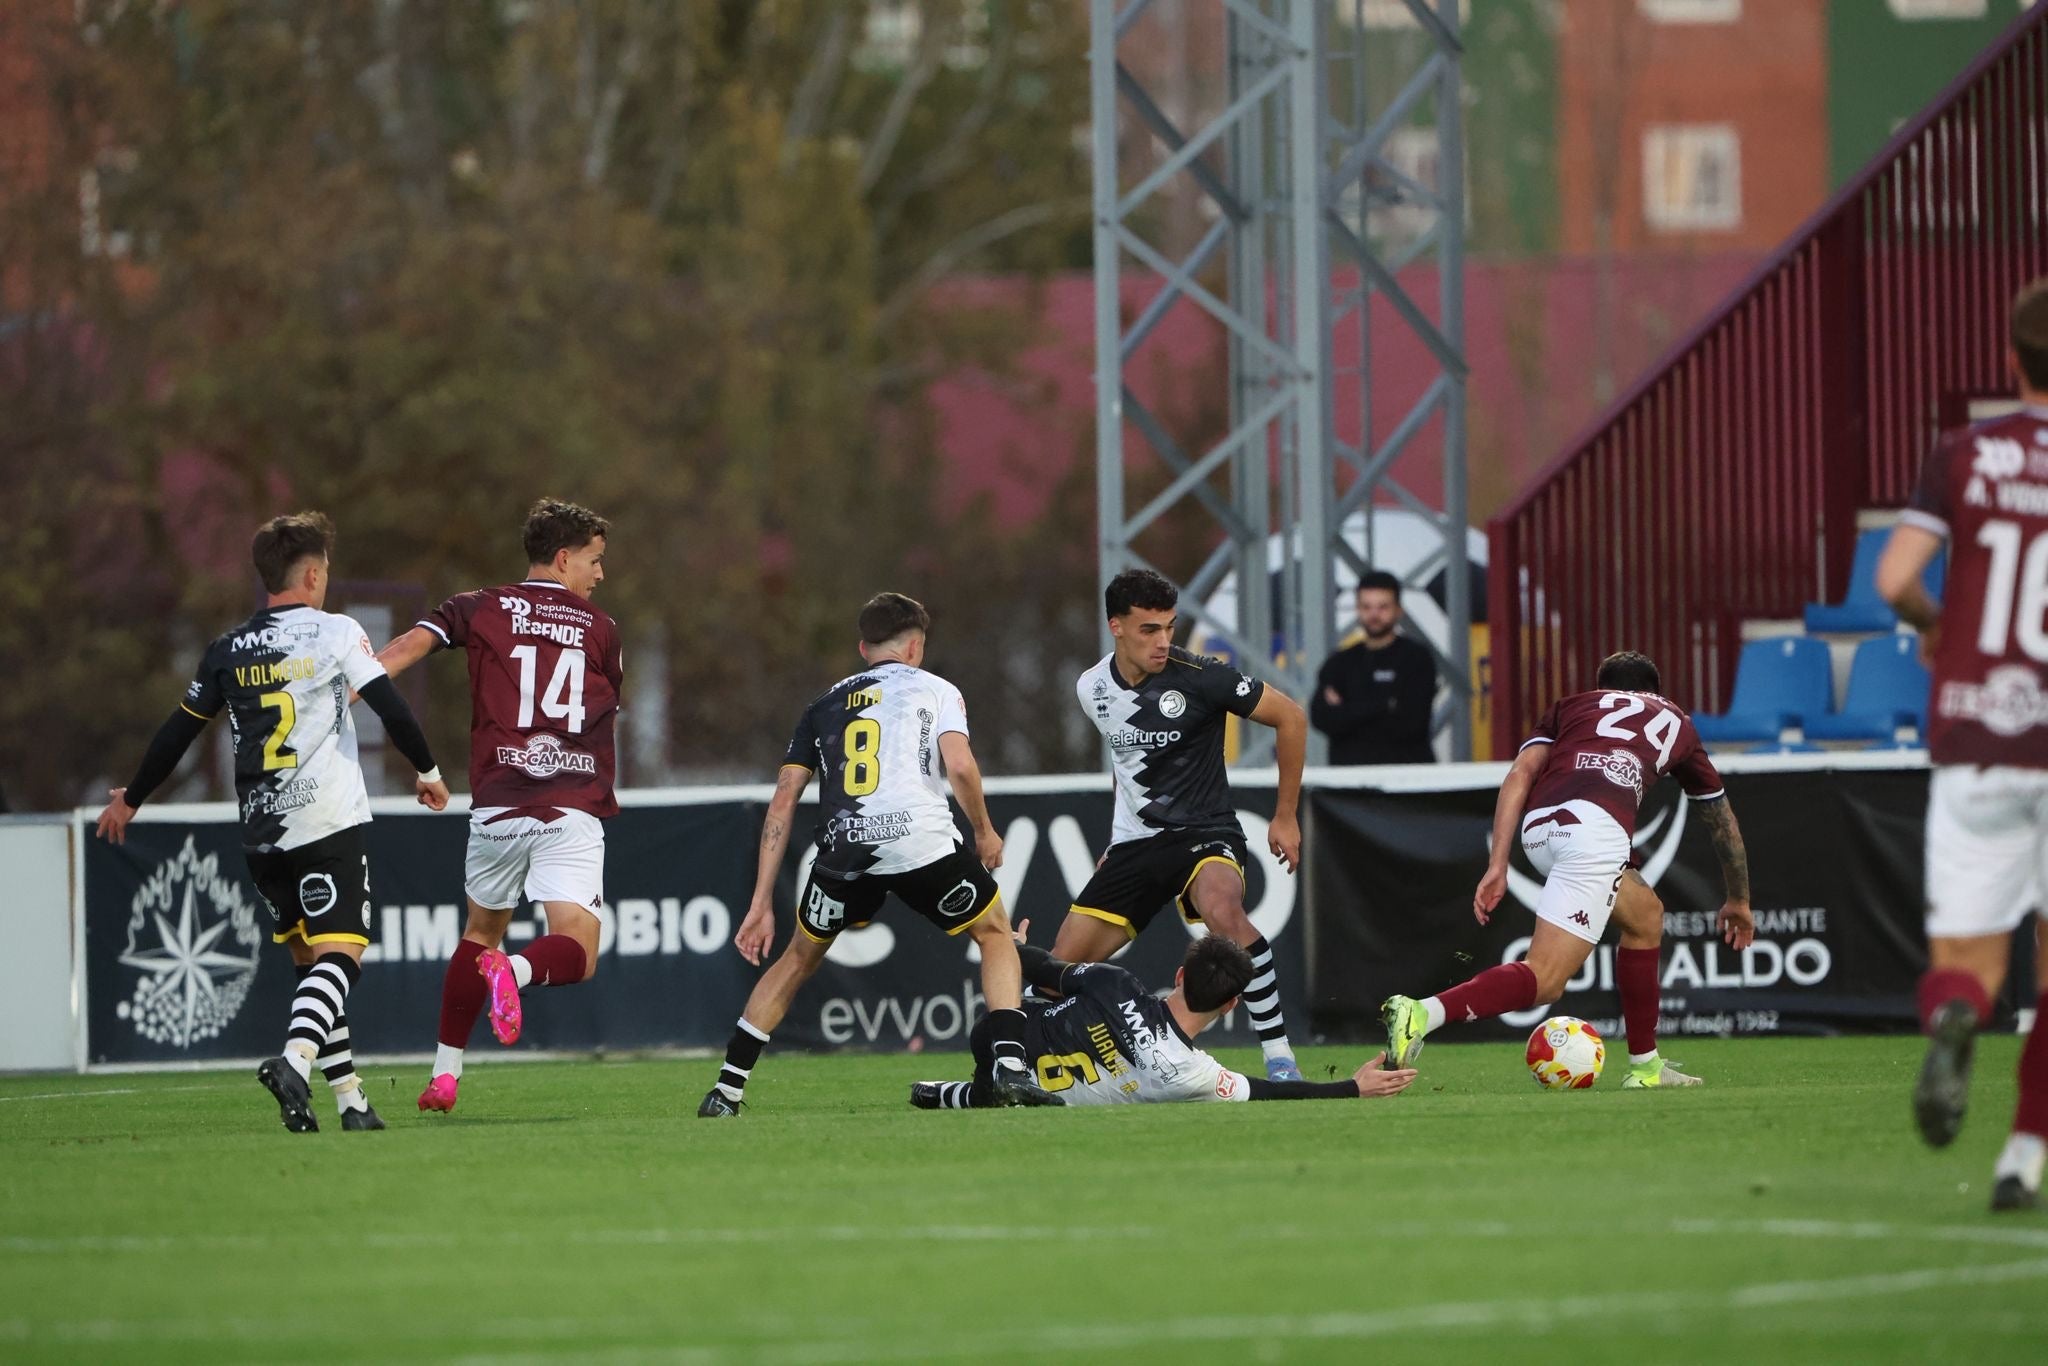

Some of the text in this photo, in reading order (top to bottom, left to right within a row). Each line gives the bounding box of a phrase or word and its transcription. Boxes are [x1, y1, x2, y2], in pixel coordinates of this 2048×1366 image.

[1976, 519, 2048, 664] 16
[535, 603, 594, 620] Deputación
[535, 609, 592, 627] Pontevedra
[230, 627, 280, 652] MMG
[511, 614, 585, 647] RESENDE
[235, 656, 315, 687] V.OLMEDO
[509, 644, 586, 734] 14
[845, 688, 882, 710] JOTA
[260, 691, 298, 771] 2
[1106, 728, 1181, 748] telefurgo
[1595, 692, 1682, 774] 24
[496, 747, 595, 774] PESCAMAR
[843, 717, 881, 797] 8
[843, 811, 912, 830] TERNERA
[847, 824, 911, 843] CHARRA
[1662, 907, 1827, 936] RESTRANTE
[1499, 936, 1832, 1028] UIALDO
[1118, 998, 1157, 1051] MMG
[1036, 1051, 1102, 1093] 6
